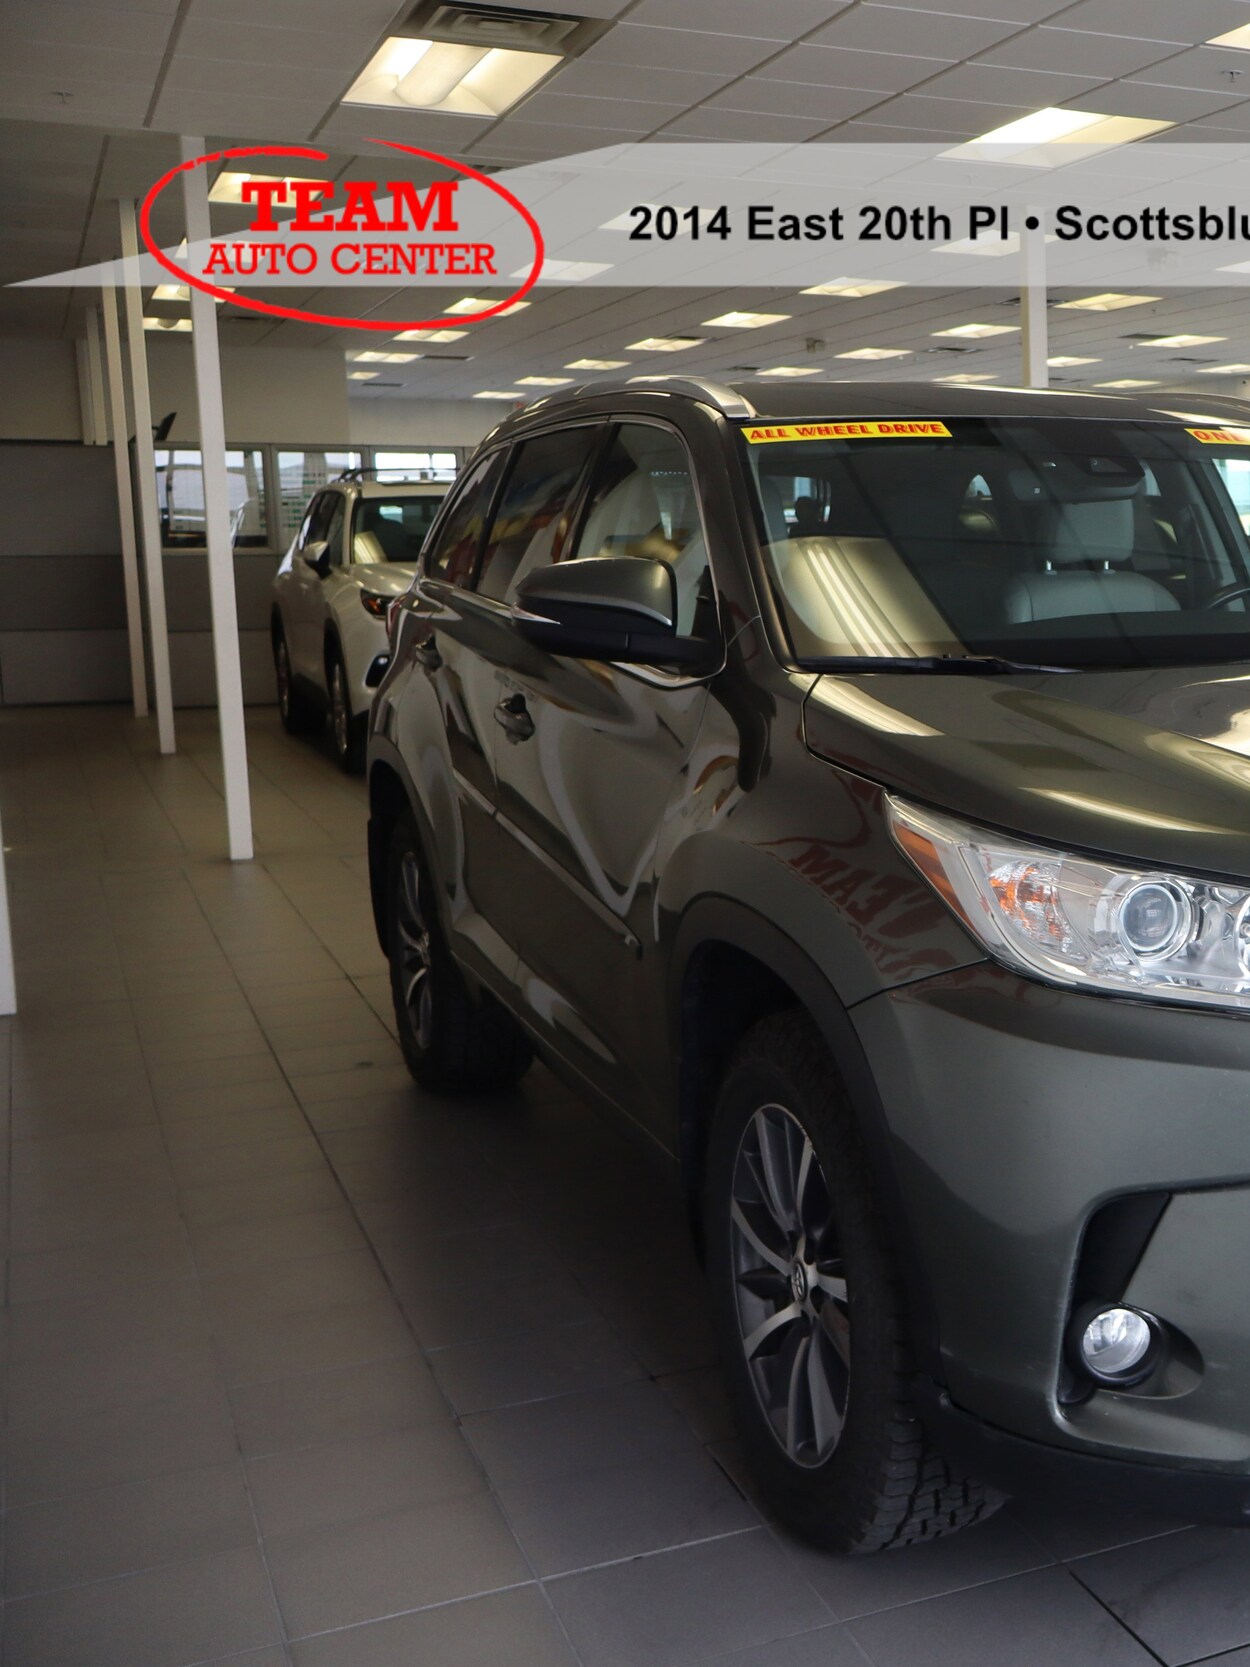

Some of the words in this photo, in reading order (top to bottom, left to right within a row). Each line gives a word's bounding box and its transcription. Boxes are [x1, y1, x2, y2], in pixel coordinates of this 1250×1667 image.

[750, 429, 790, 440] ALL
[795, 424, 874, 437] WHEEL
[877, 423, 945, 434] DRIVE
[1193, 430, 1243, 443] ONE
